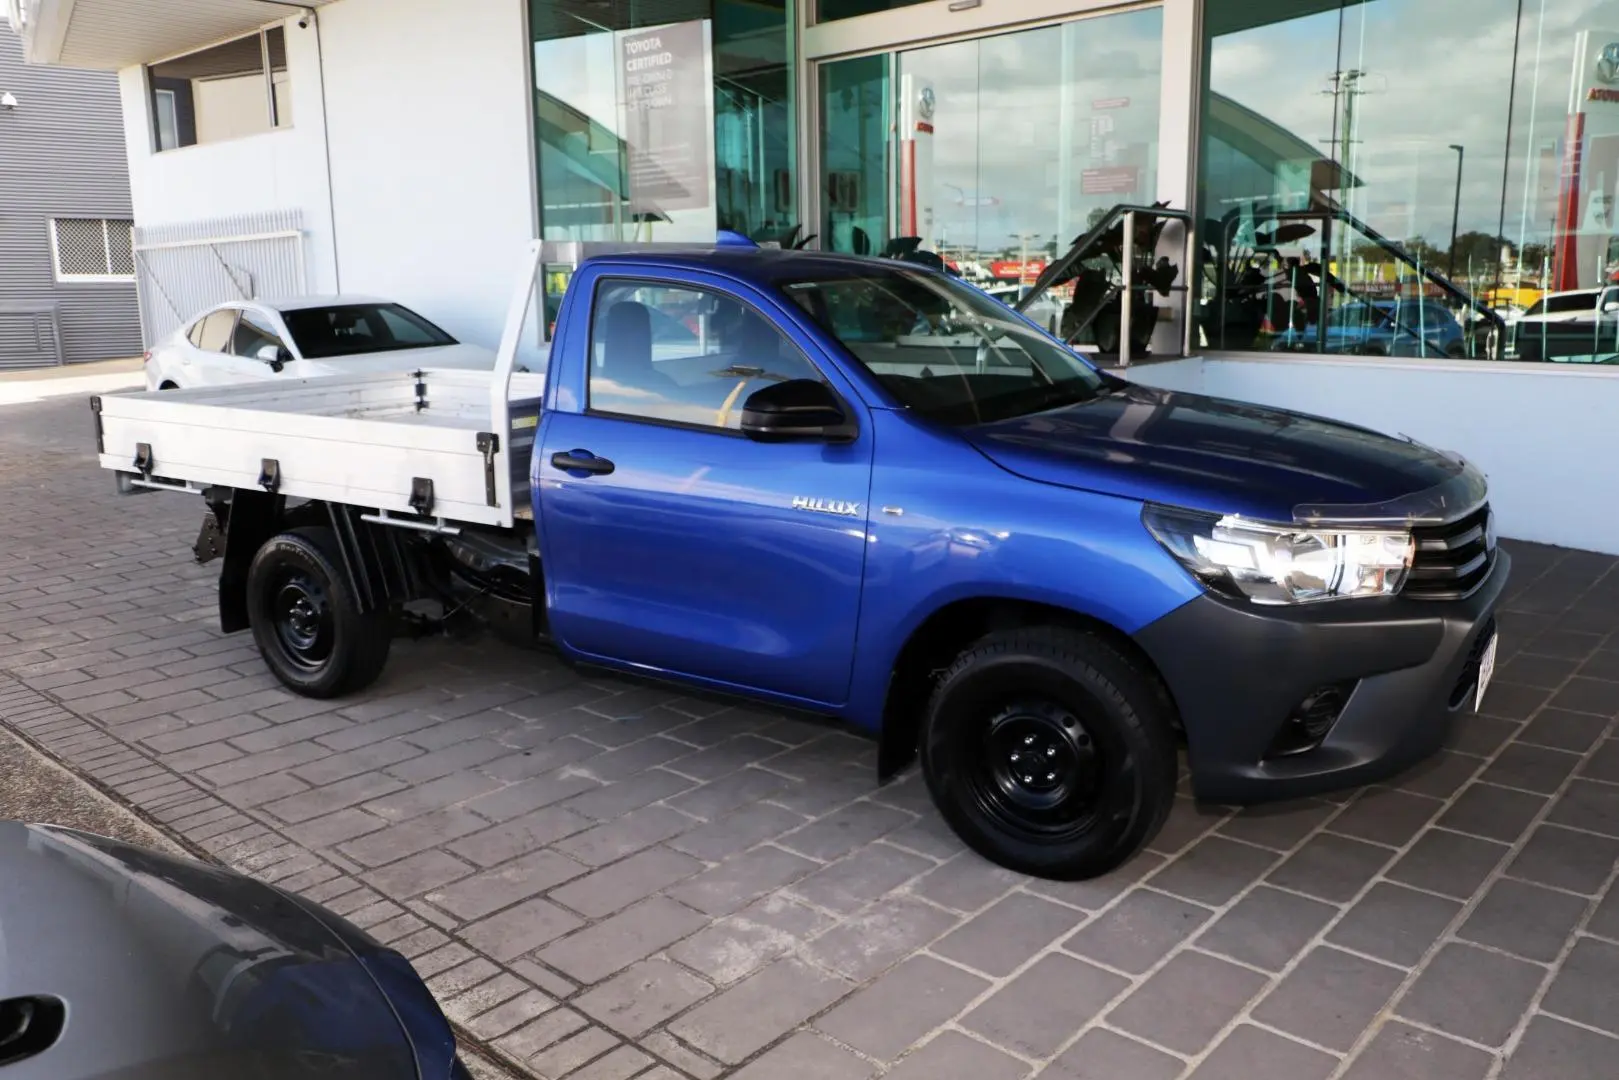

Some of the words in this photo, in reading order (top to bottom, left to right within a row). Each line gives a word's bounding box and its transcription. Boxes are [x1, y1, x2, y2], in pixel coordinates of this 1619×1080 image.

[626, 37, 662, 54] TOYOTA
[626, 53, 672, 71] CERTIFIED
[793, 496, 860, 516] HILUX
